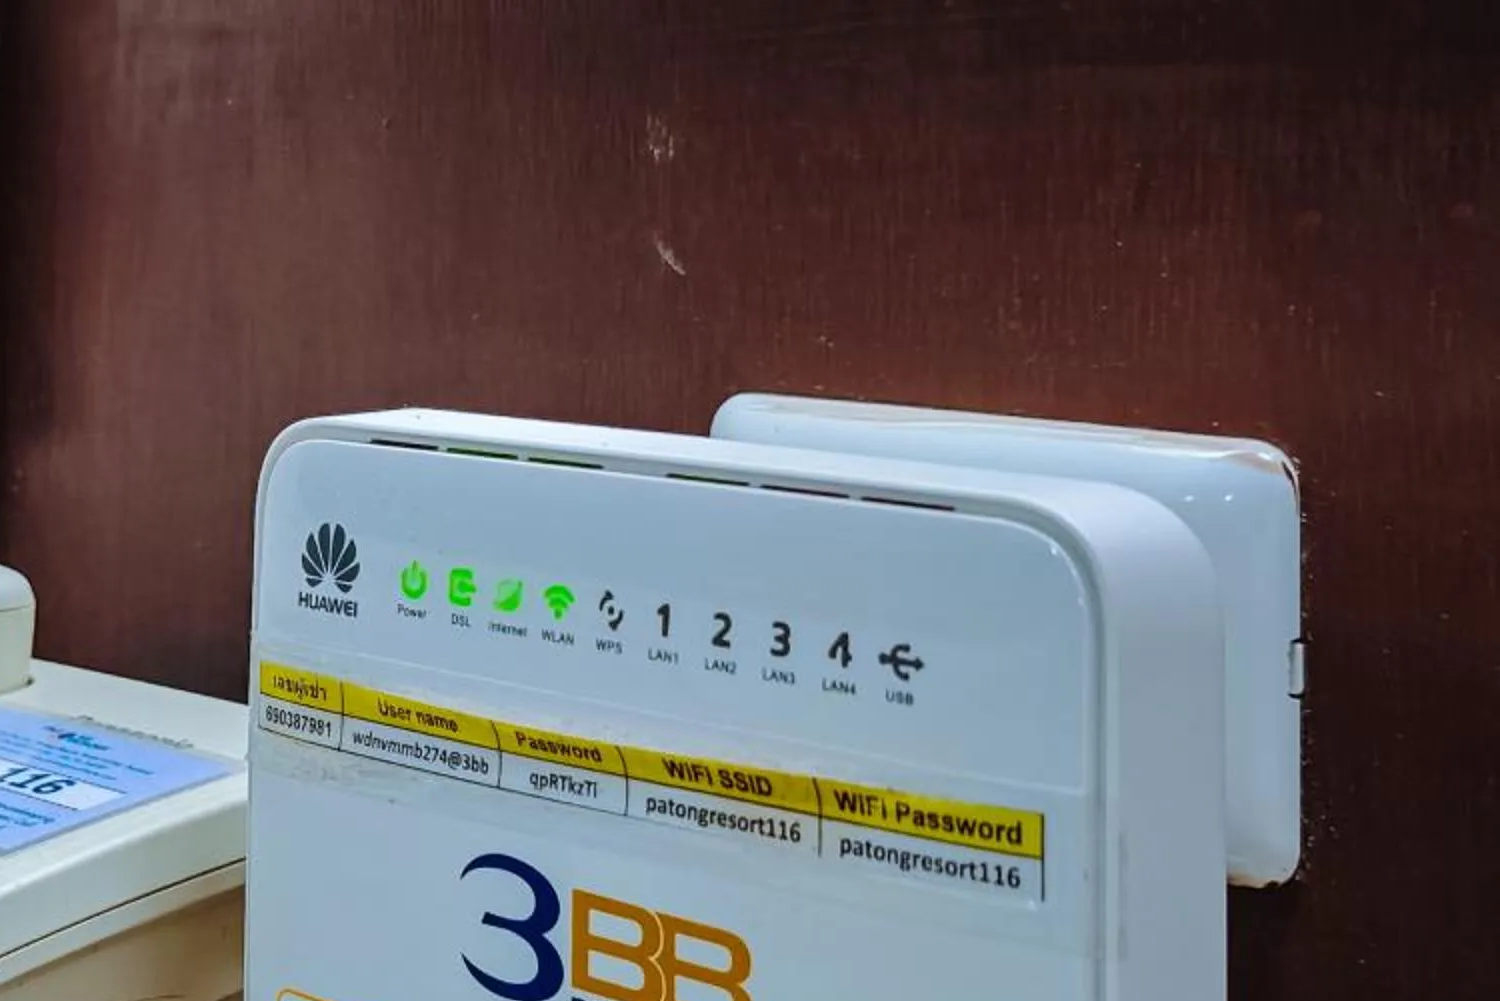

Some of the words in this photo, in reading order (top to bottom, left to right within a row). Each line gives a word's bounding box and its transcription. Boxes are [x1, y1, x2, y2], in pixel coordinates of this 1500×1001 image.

[297, 591, 359, 619] HUAWEI
[397, 603, 429, 619] Power
[450, 612, 471, 628] DSL
[656, 603, 672, 638] 1
[711, 612, 734, 649] 2
[541, 629, 576, 646] WLAN
[595, 638, 624, 654] WPS
[769, 621, 792, 657] 3
[827, 631, 854, 669] 4
[647, 646, 680, 666] LAN1
[704, 656, 738, 676] LAN2
[761, 667, 797, 685] LAN3
[821, 677, 858, 696] LAN4
[885, 688, 915, 707] USB
[376, 696, 412, 722] User
[416, 709, 460, 734] name
[514, 730, 603, 764] Password
[716, 767, 773, 799] SSID
[645, 794, 802, 844] patongresort116
[895, 802, 1024, 847] Password
[839, 835, 1022, 890] patongresort116
